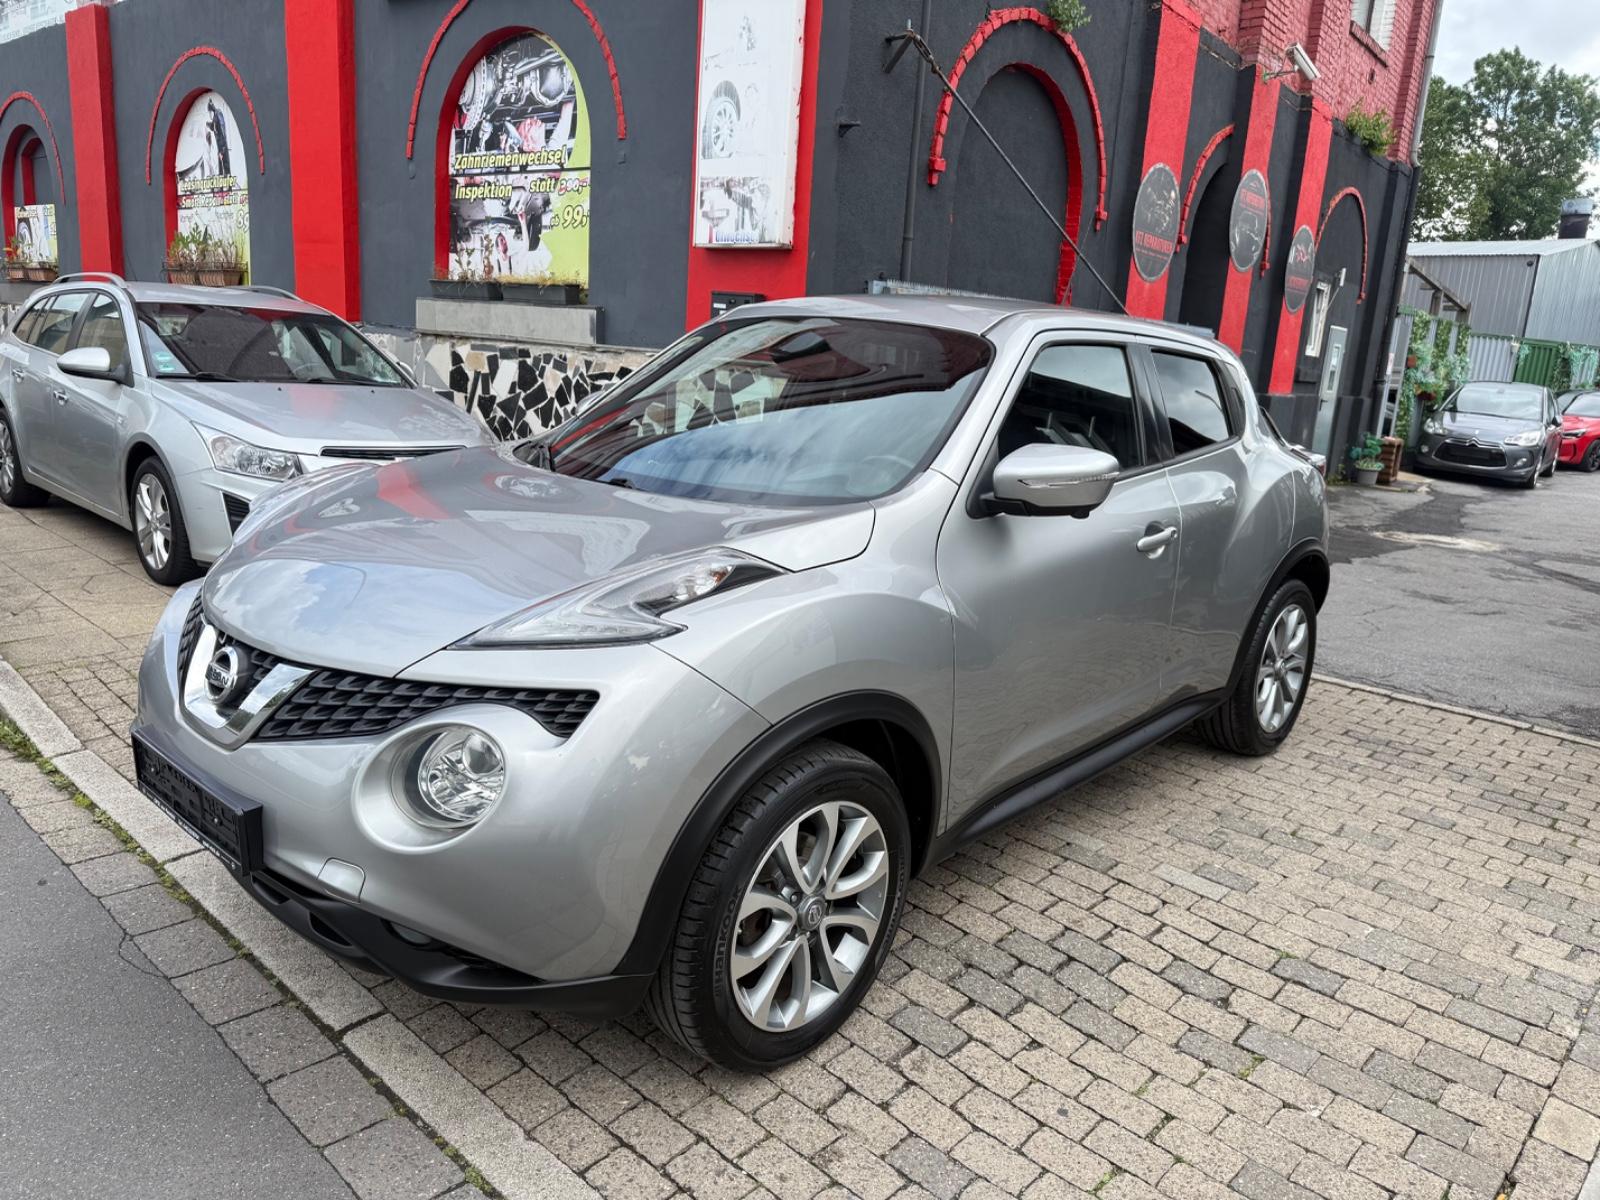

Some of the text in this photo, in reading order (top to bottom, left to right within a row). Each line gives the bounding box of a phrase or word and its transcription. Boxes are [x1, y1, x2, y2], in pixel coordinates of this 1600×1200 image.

[455, 145, 568, 169] Zahnriemenwechsel
[455, 184, 512, 202] Inspektion
[530, 178, 556, 193] statt
